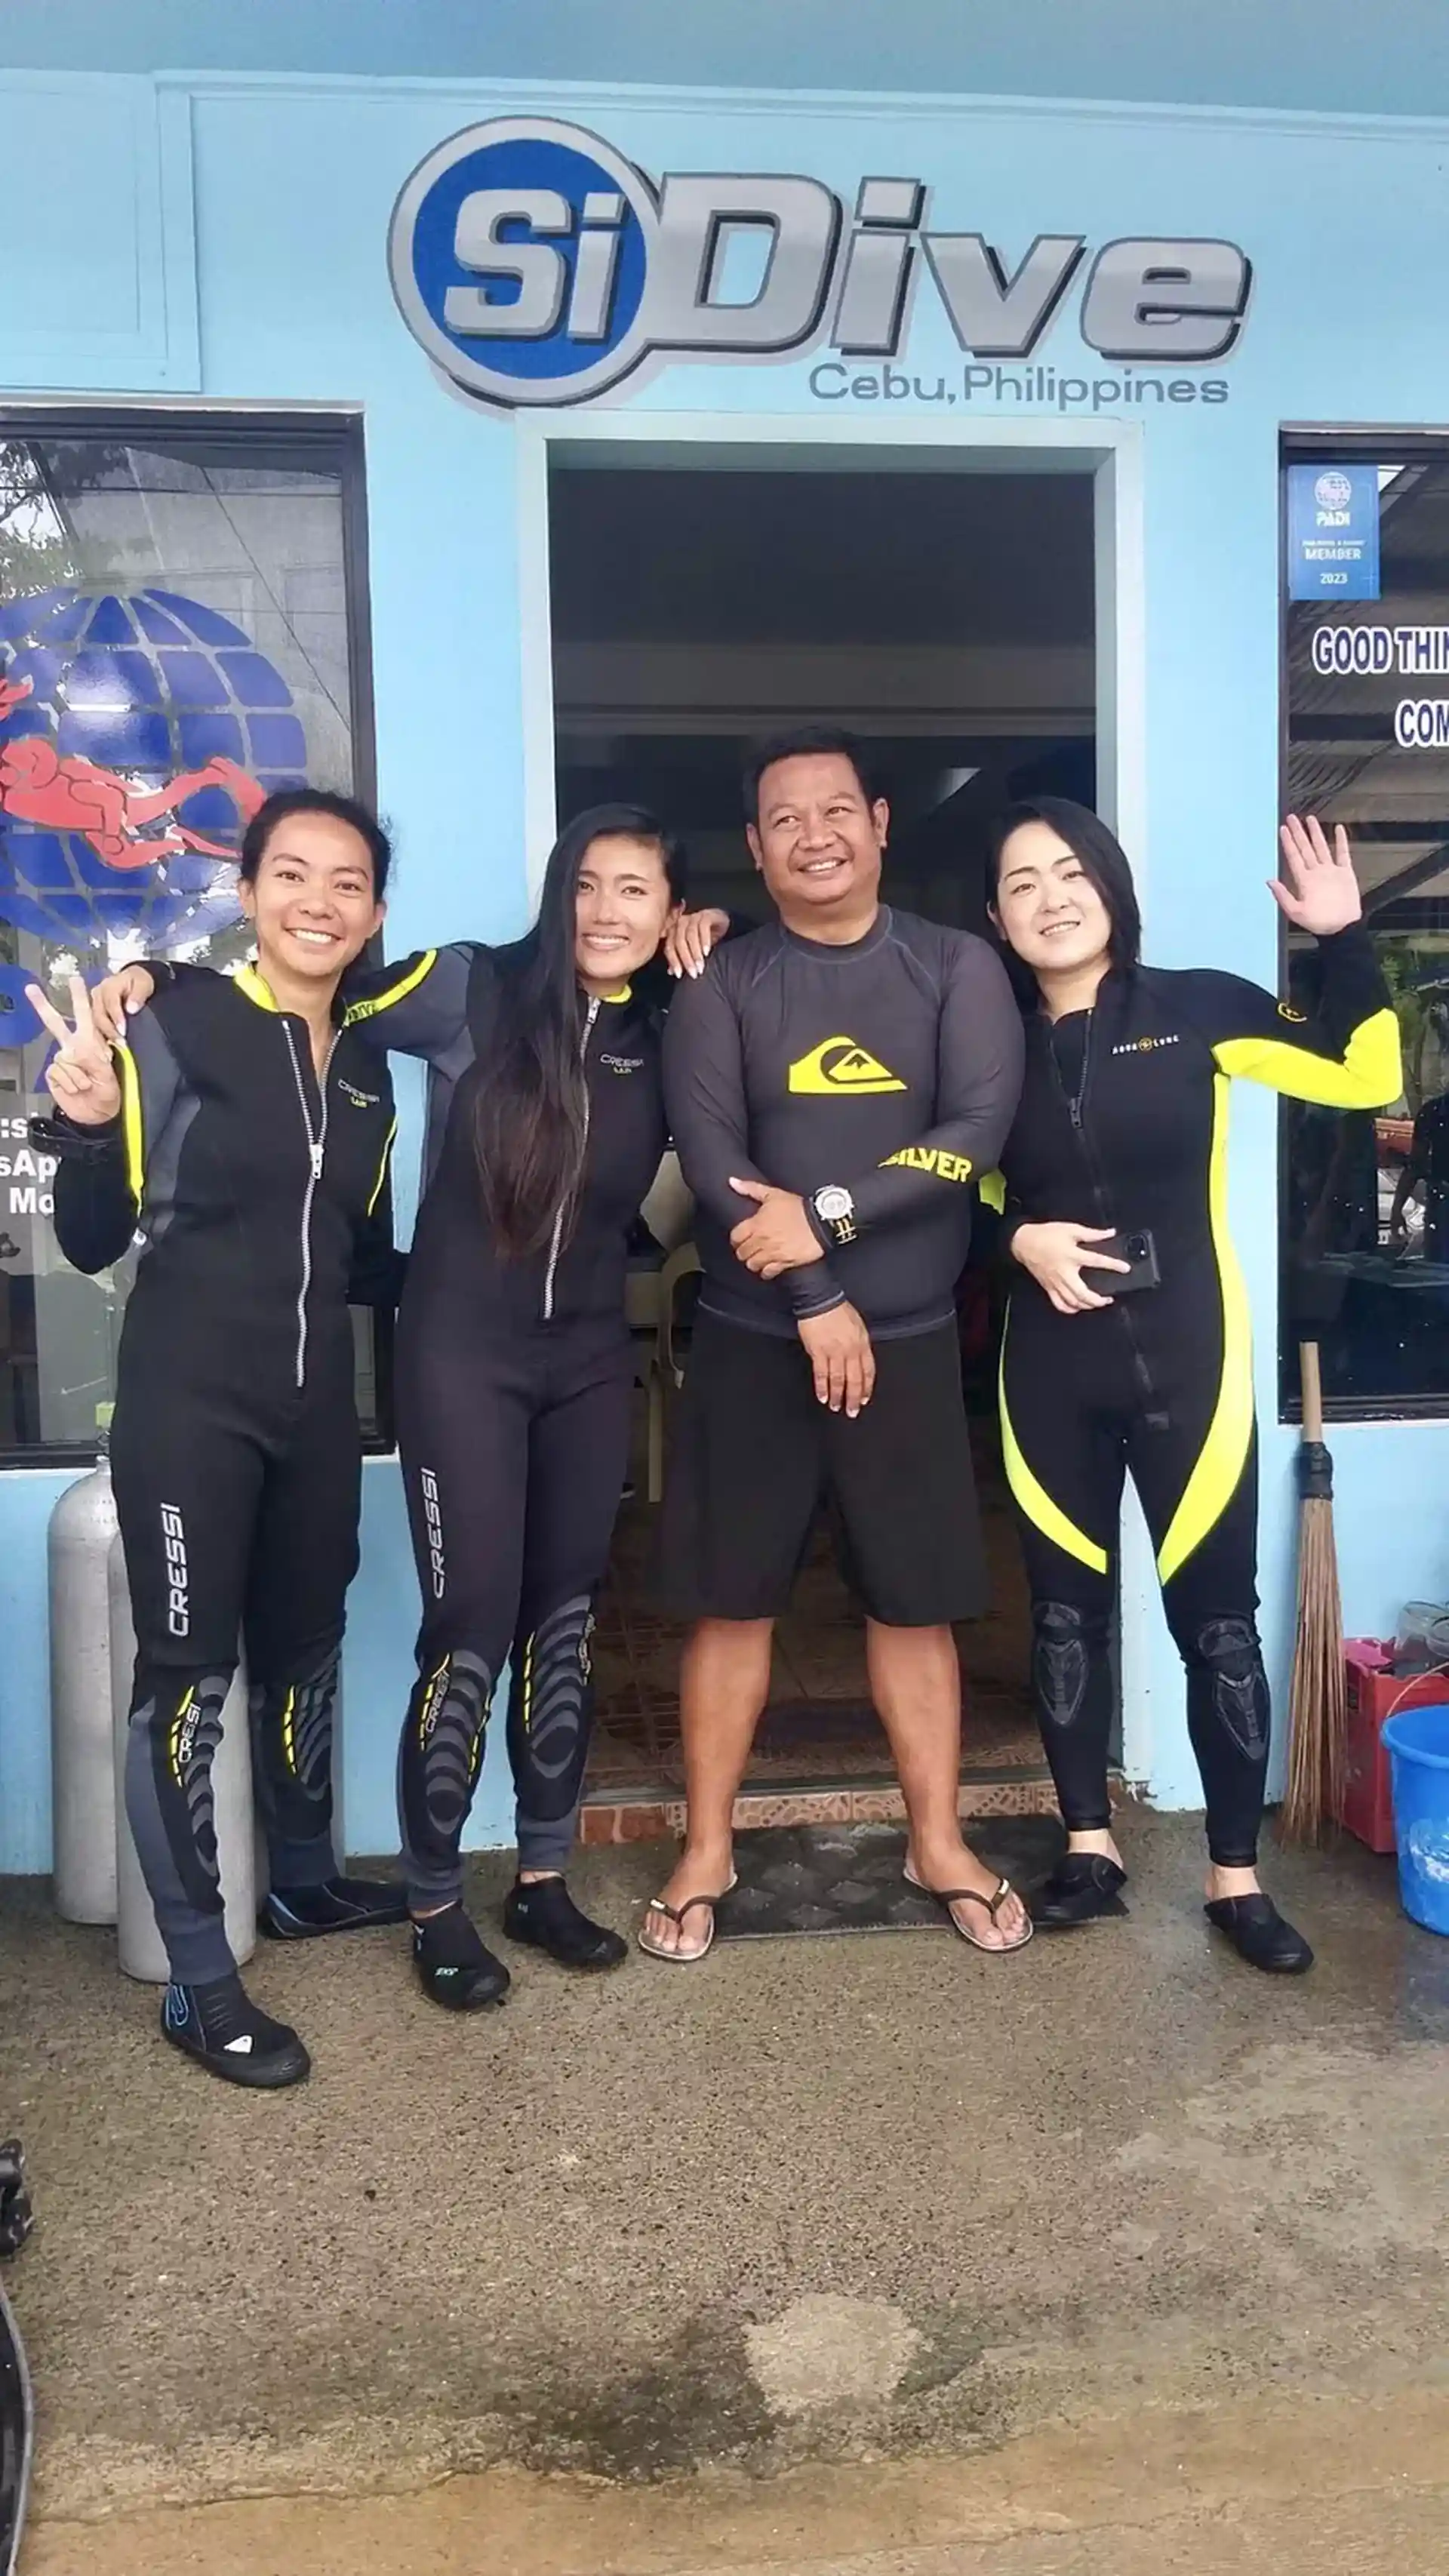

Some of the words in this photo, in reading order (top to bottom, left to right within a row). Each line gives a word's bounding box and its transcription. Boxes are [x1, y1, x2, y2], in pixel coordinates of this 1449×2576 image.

[808, 362, 957, 404] Cebu,
[963, 365, 1230, 411] Philippines
[1315, 511, 1351, 527] PADI
[1305, 547, 1361, 561] MEMBER
[1319, 572, 1348, 584] 2023
[1313, 627, 1392, 674] GOOD
[421, 1467, 445, 1599] CRESSI
[159, 1502, 189, 1637] CRESSI
[178, 1702, 202, 1763] CRESSI
